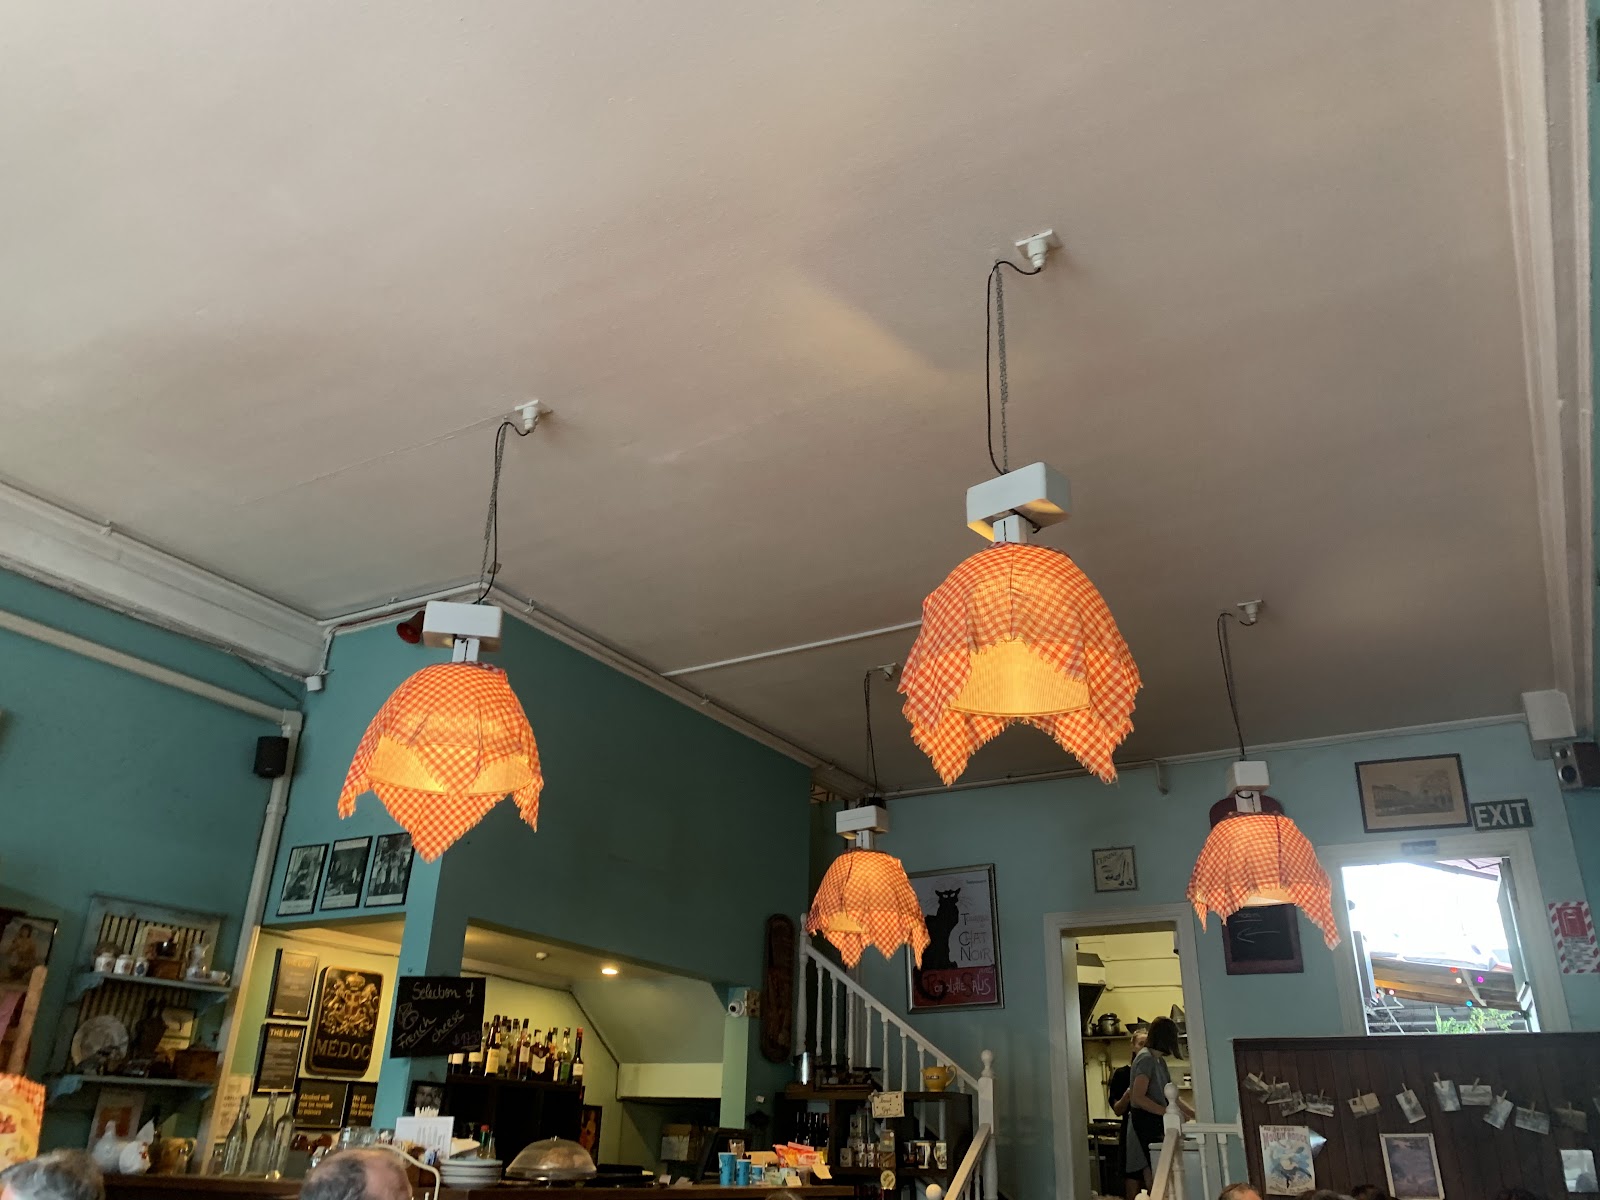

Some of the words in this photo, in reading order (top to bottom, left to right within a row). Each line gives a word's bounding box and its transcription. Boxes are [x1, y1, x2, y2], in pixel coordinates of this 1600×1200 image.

[1474, 803, 1526, 827] EXIT
[958, 930, 987, 947] CHAT
[960, 947, 992, 962] NOIR
[411, 981, 461, 1000] Selection
[465, 981, 475, 1005] of
[270, 1029, 283, 1037] THE
[284, 1029, 301, 1038] LAW
[396, 1016, 438, 1049] French
[432, 1009, 465, 1042] cheese
